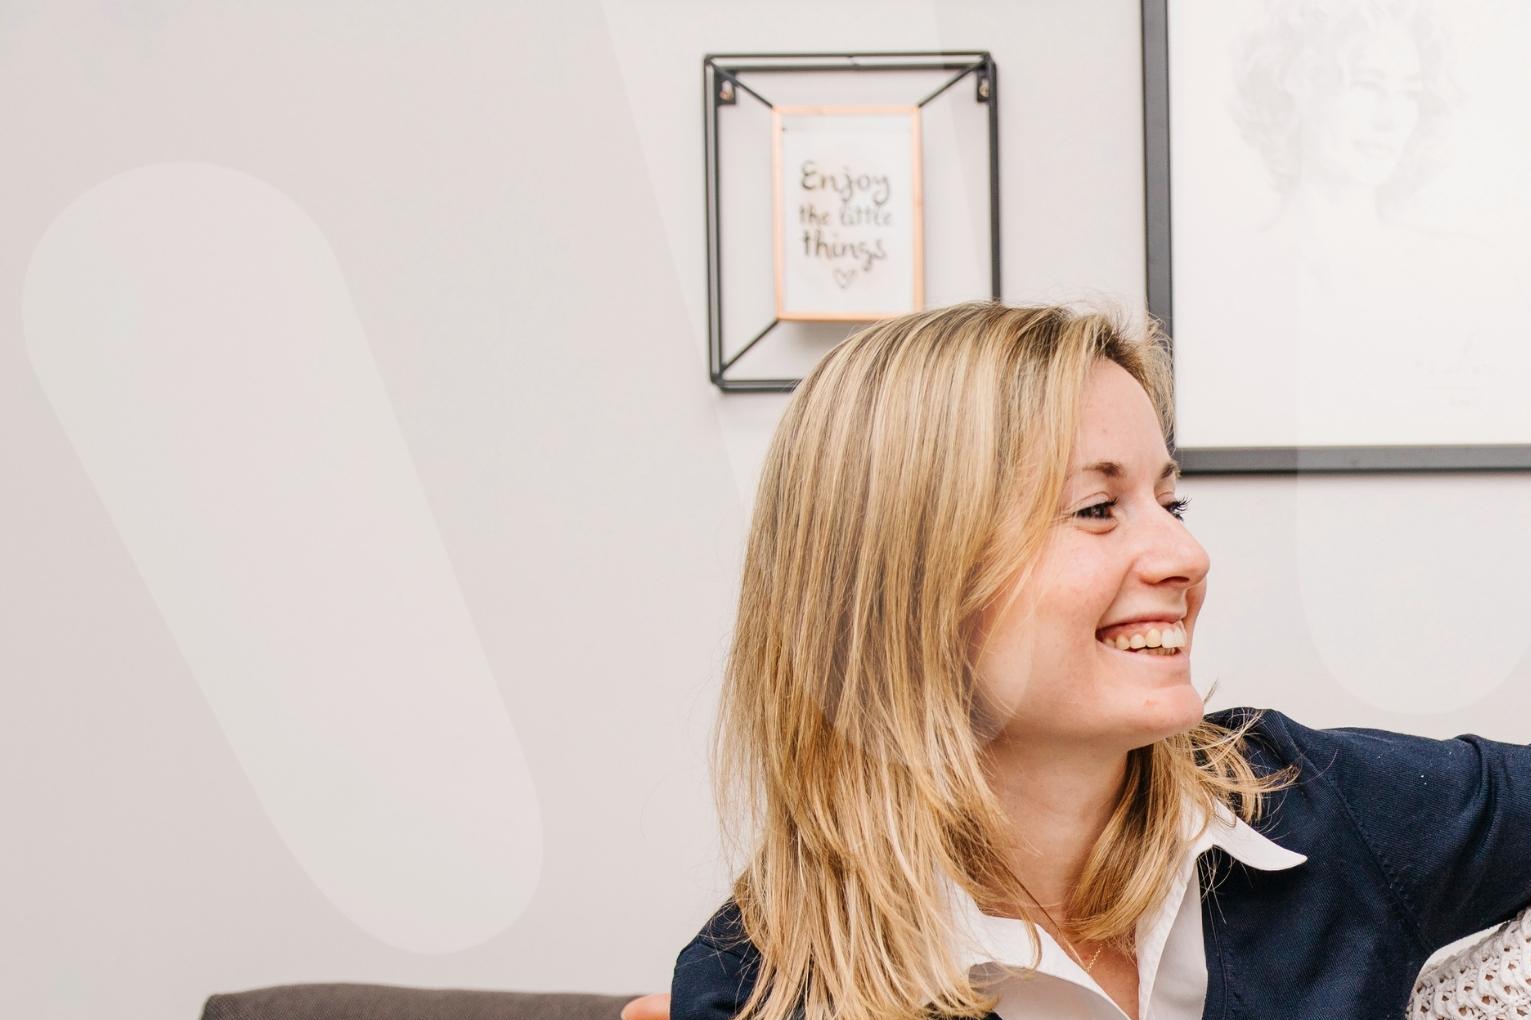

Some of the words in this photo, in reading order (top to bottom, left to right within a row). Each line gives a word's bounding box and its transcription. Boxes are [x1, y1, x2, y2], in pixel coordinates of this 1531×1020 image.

[800, 160, 890, 206] Enjoy
[800, 205, 830, 225] the
[840, 204, 892, 226] little
[802, 229, 886, 272] things
